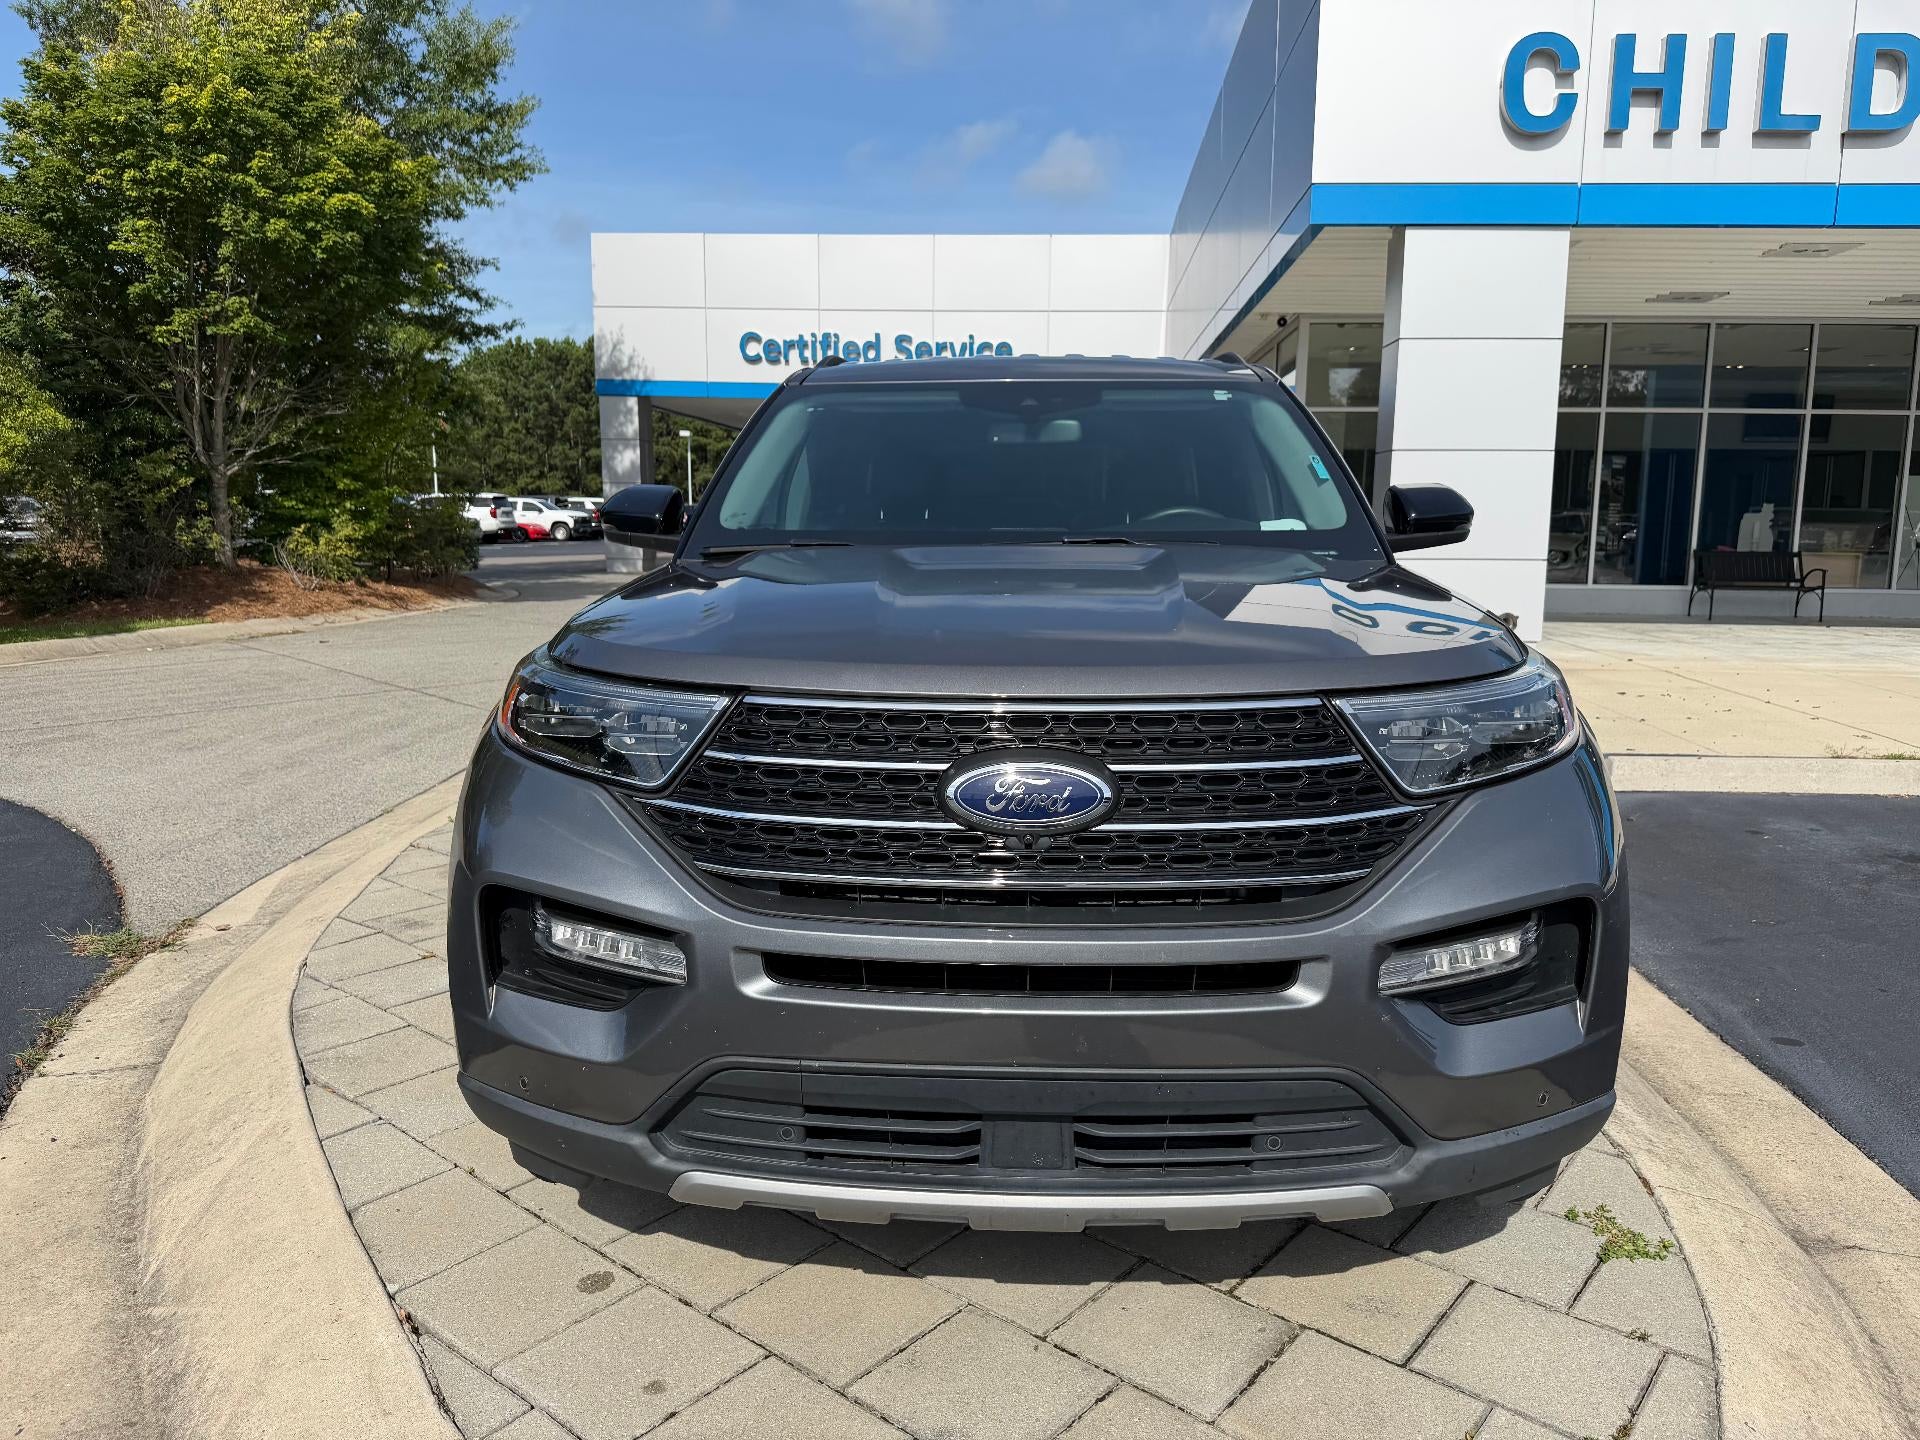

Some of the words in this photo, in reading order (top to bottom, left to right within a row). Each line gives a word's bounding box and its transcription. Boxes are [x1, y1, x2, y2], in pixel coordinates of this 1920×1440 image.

[1501, 31, 1920, 135] CHILD
[739, 331, 881, 364] Certified
[894, 334, 1013, 359] Service
[985, 776, 1073, 812] Ford
